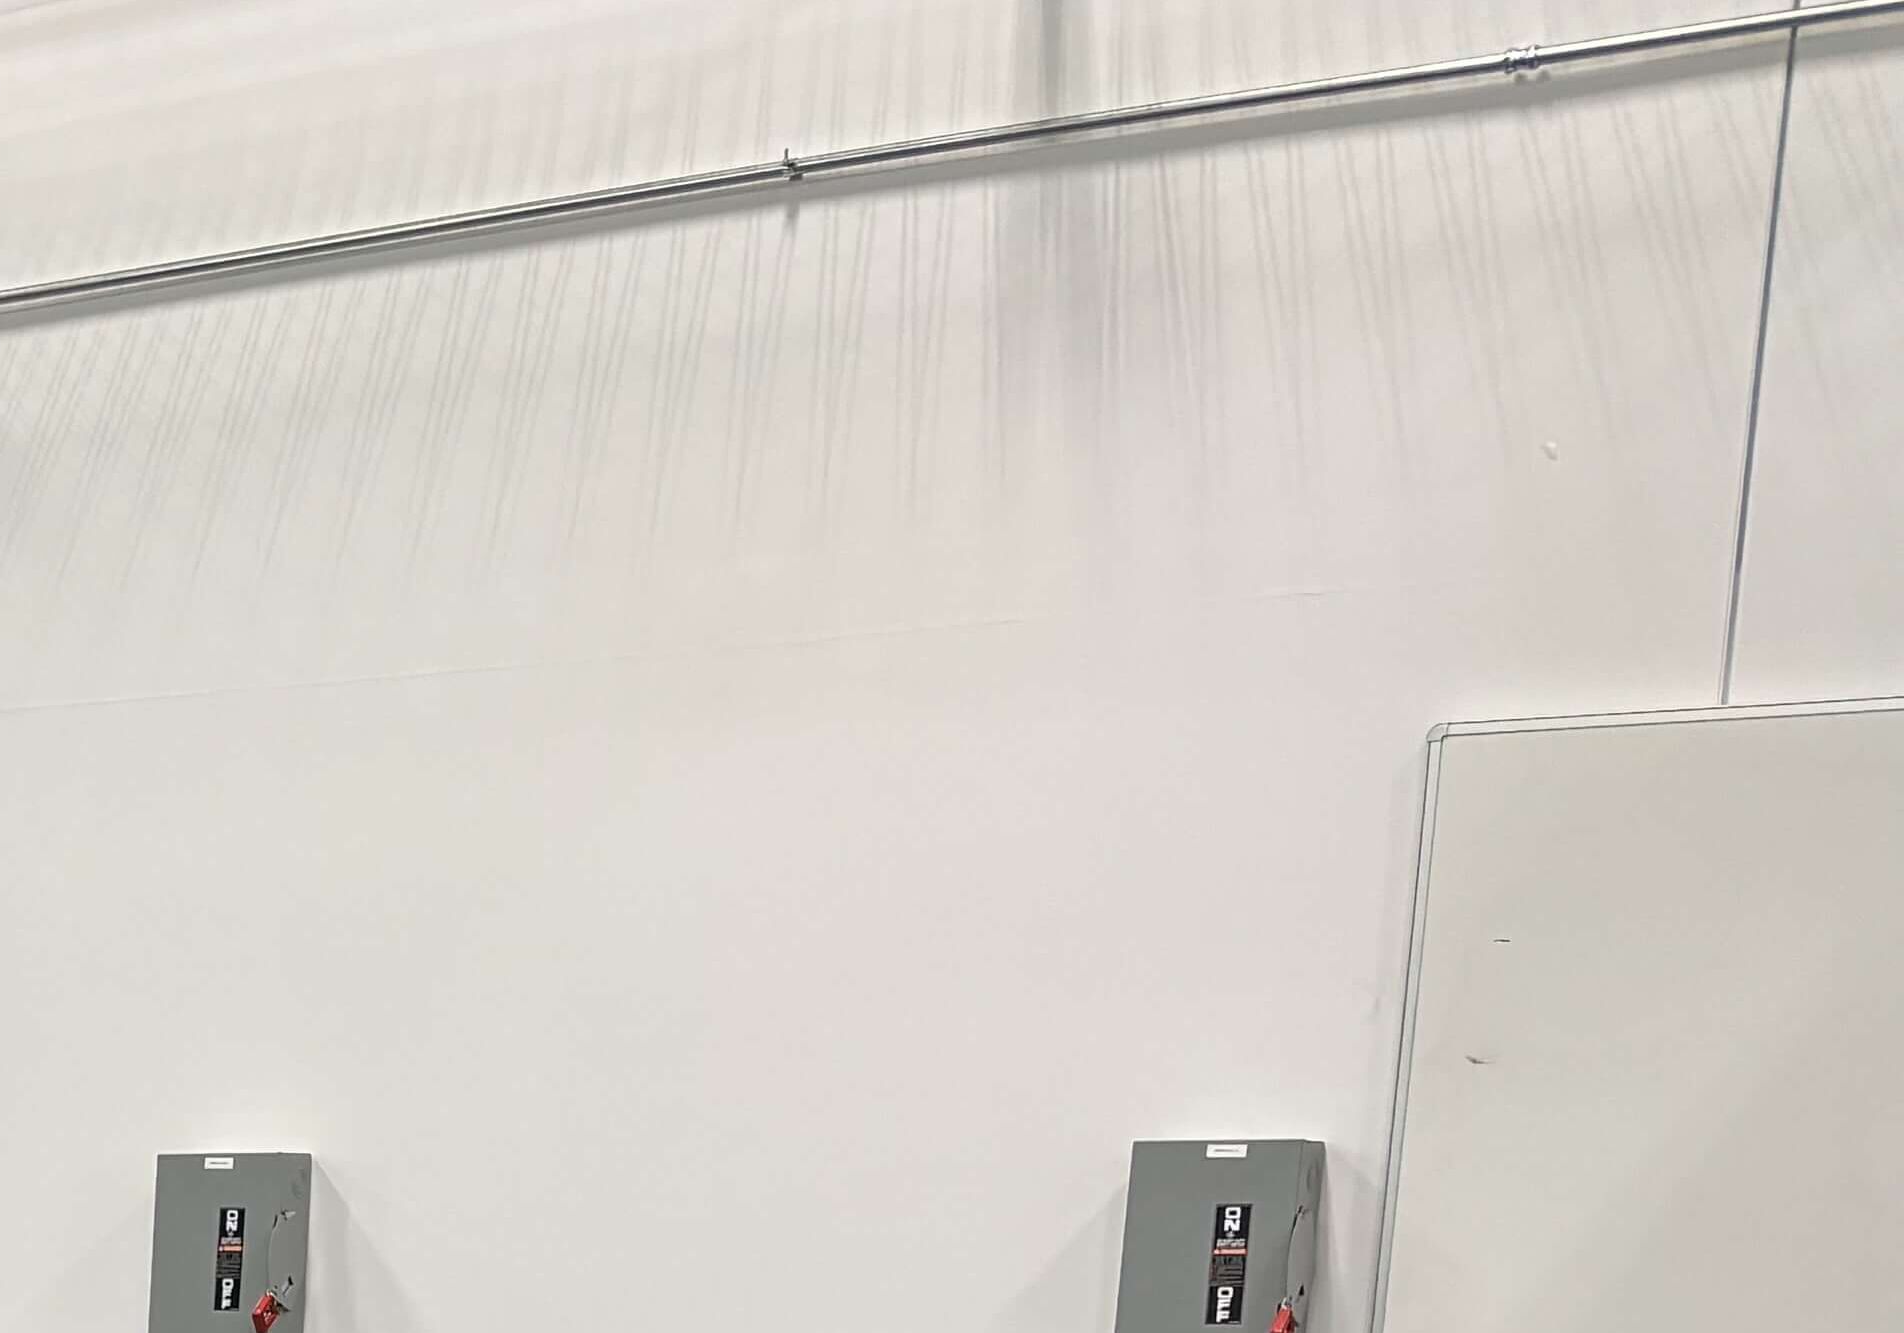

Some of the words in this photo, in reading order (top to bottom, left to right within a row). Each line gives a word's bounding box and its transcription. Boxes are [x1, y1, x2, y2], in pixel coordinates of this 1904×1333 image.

[225, 1210, 239, 1232] ON
[1223, 1206, 1242, 1232] ON
[1215, 1286, 1234, 1323] OFF
